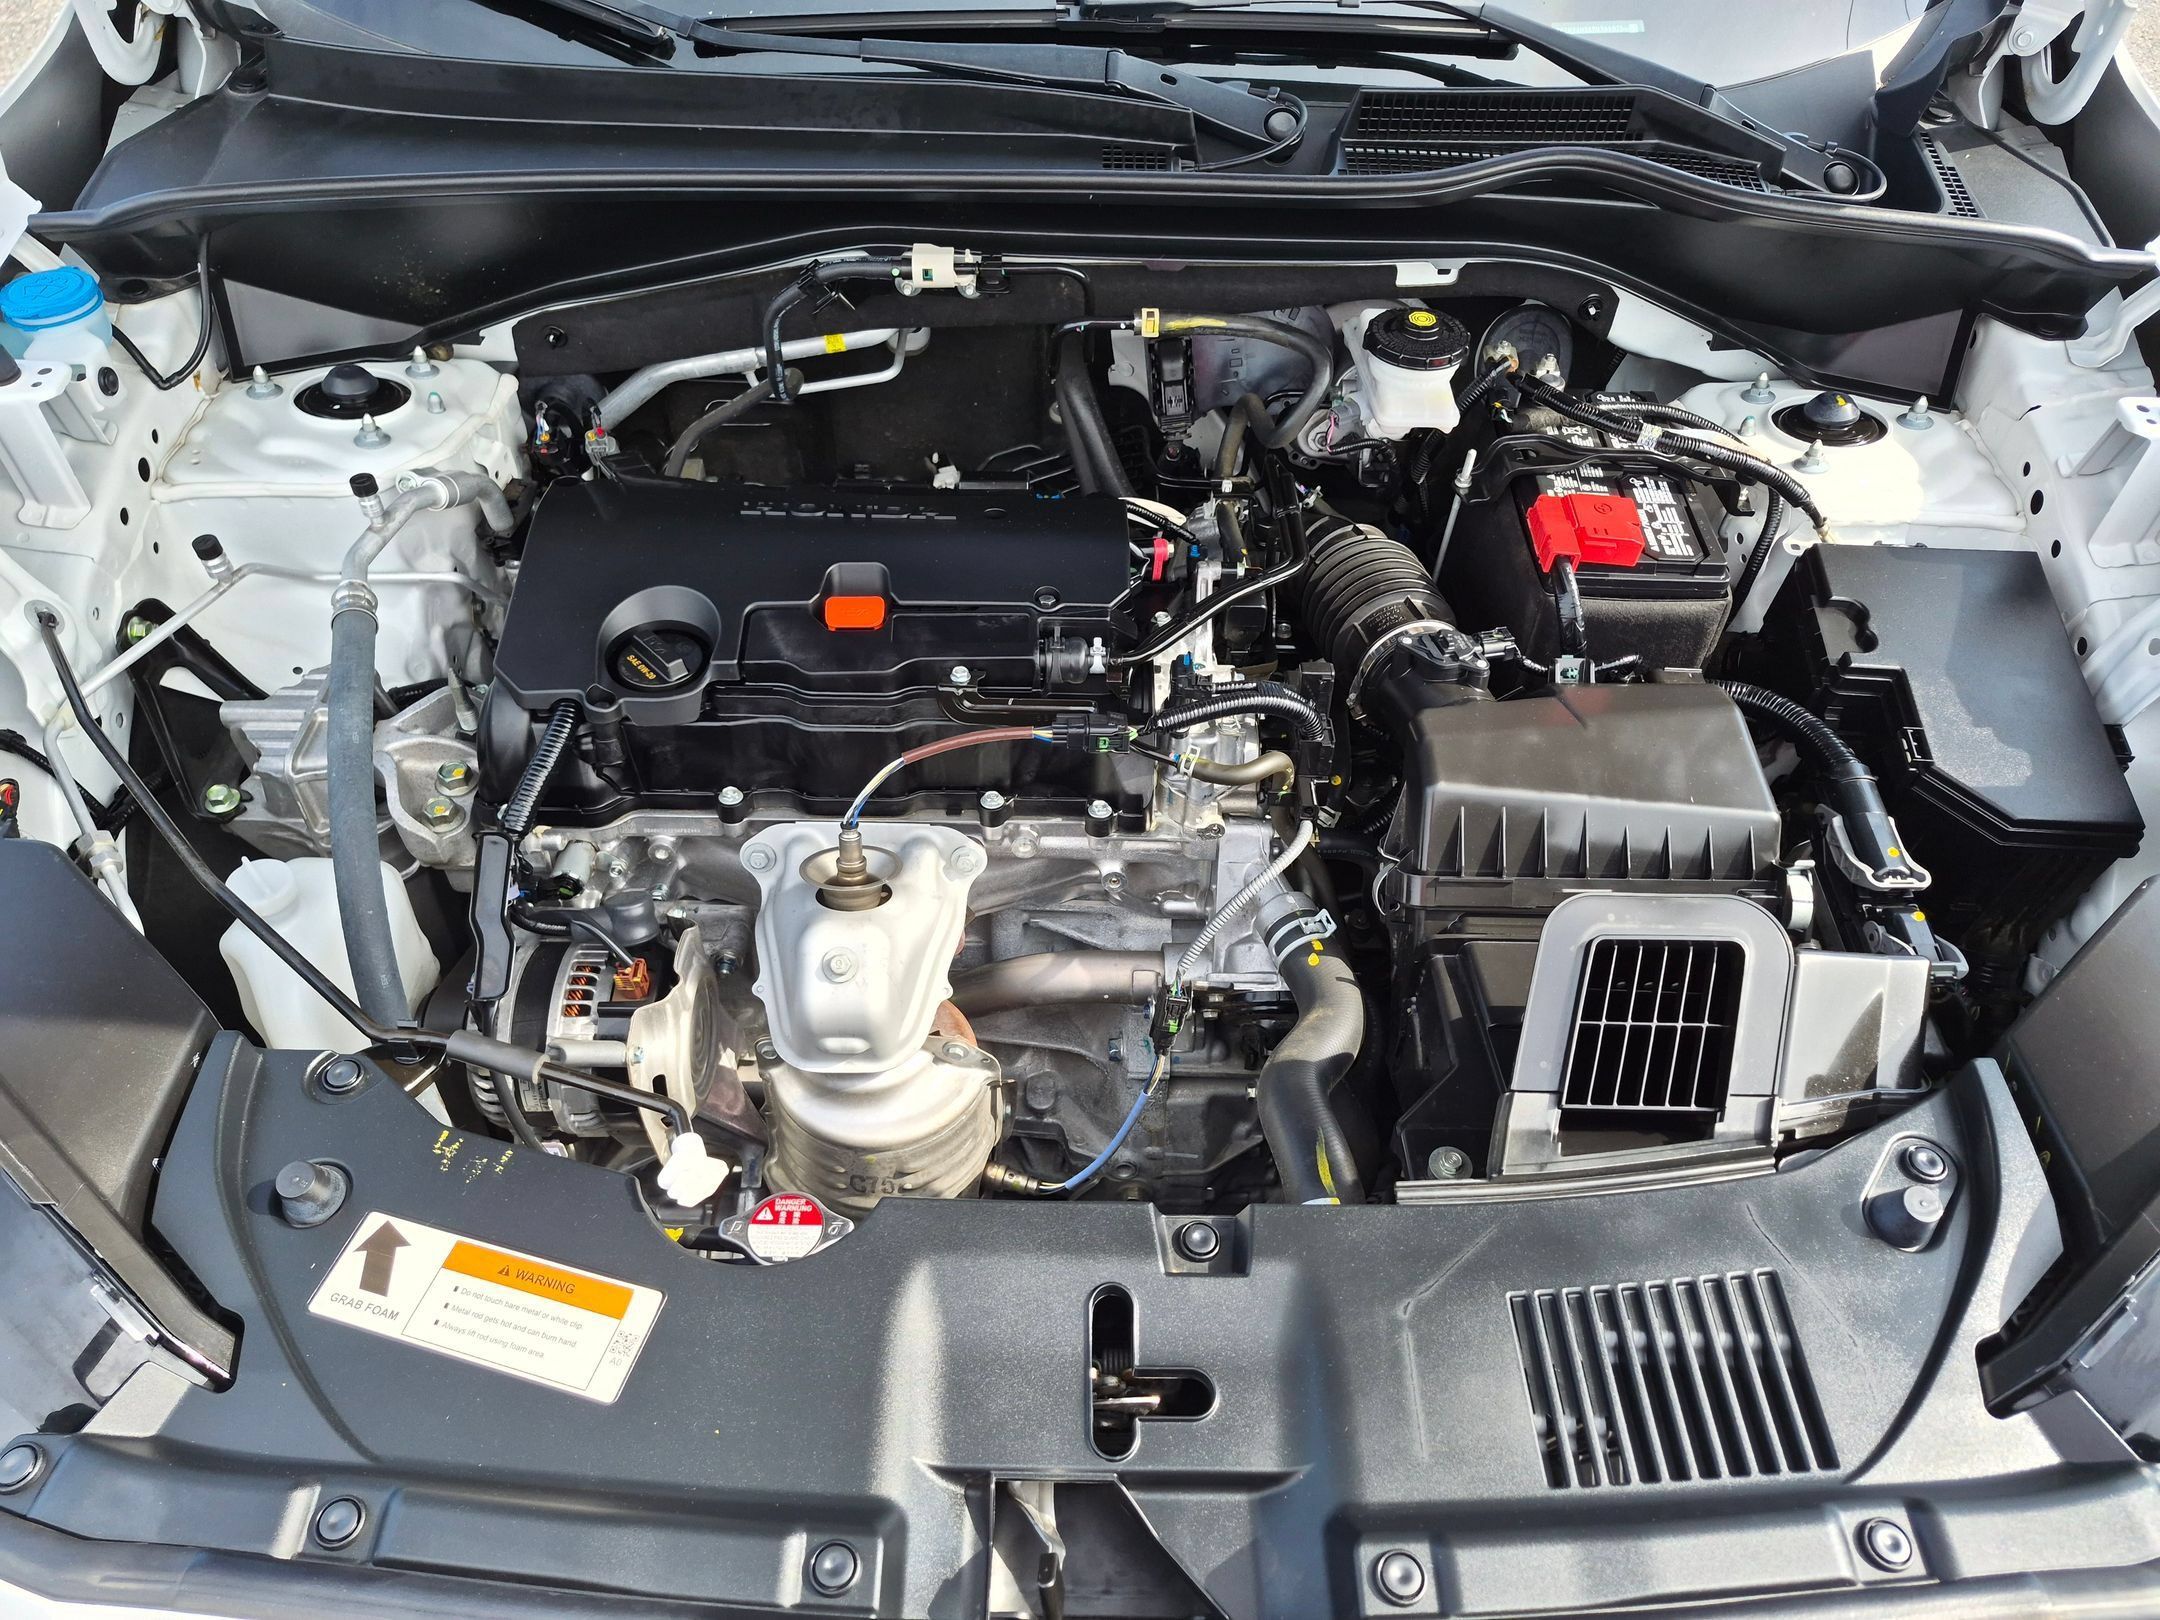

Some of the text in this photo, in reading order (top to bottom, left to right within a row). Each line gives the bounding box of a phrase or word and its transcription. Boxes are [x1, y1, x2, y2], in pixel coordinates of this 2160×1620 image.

[626, 654, 642, 668] SAE
[515, 1268, 576, 1295] WARNING
[330, 1292, 400, 1321] GRAB FOAM
[451, 1304, 471, 1316] Metal
[471, 1310, 484, 1320] rod
[483, 1313, 499, 1324] gets
[500, 1318, 513, 1328] hot
[512, 1322, 527, 1334] and
[526, 1327, 540, 1337] can
[460, 1287, 471, 1297] Do
[472, 1290, 484, 1300] not
[484, 1294, 504, 1306] touch
[504, 1301, 521, 1311] bare
[521, 1306, 541, 1317] metal
[540, 1310, 550, 1319] or
[550, 1314, 569, 1326] white
[441, 1321, 466, 1336] Always
[467, 1327, 477, 1337] lift
[476, 1330, 489, 1341] rod
[489, 1336, 509, 1349] using
[509, 1340, 528, 1353] foam
